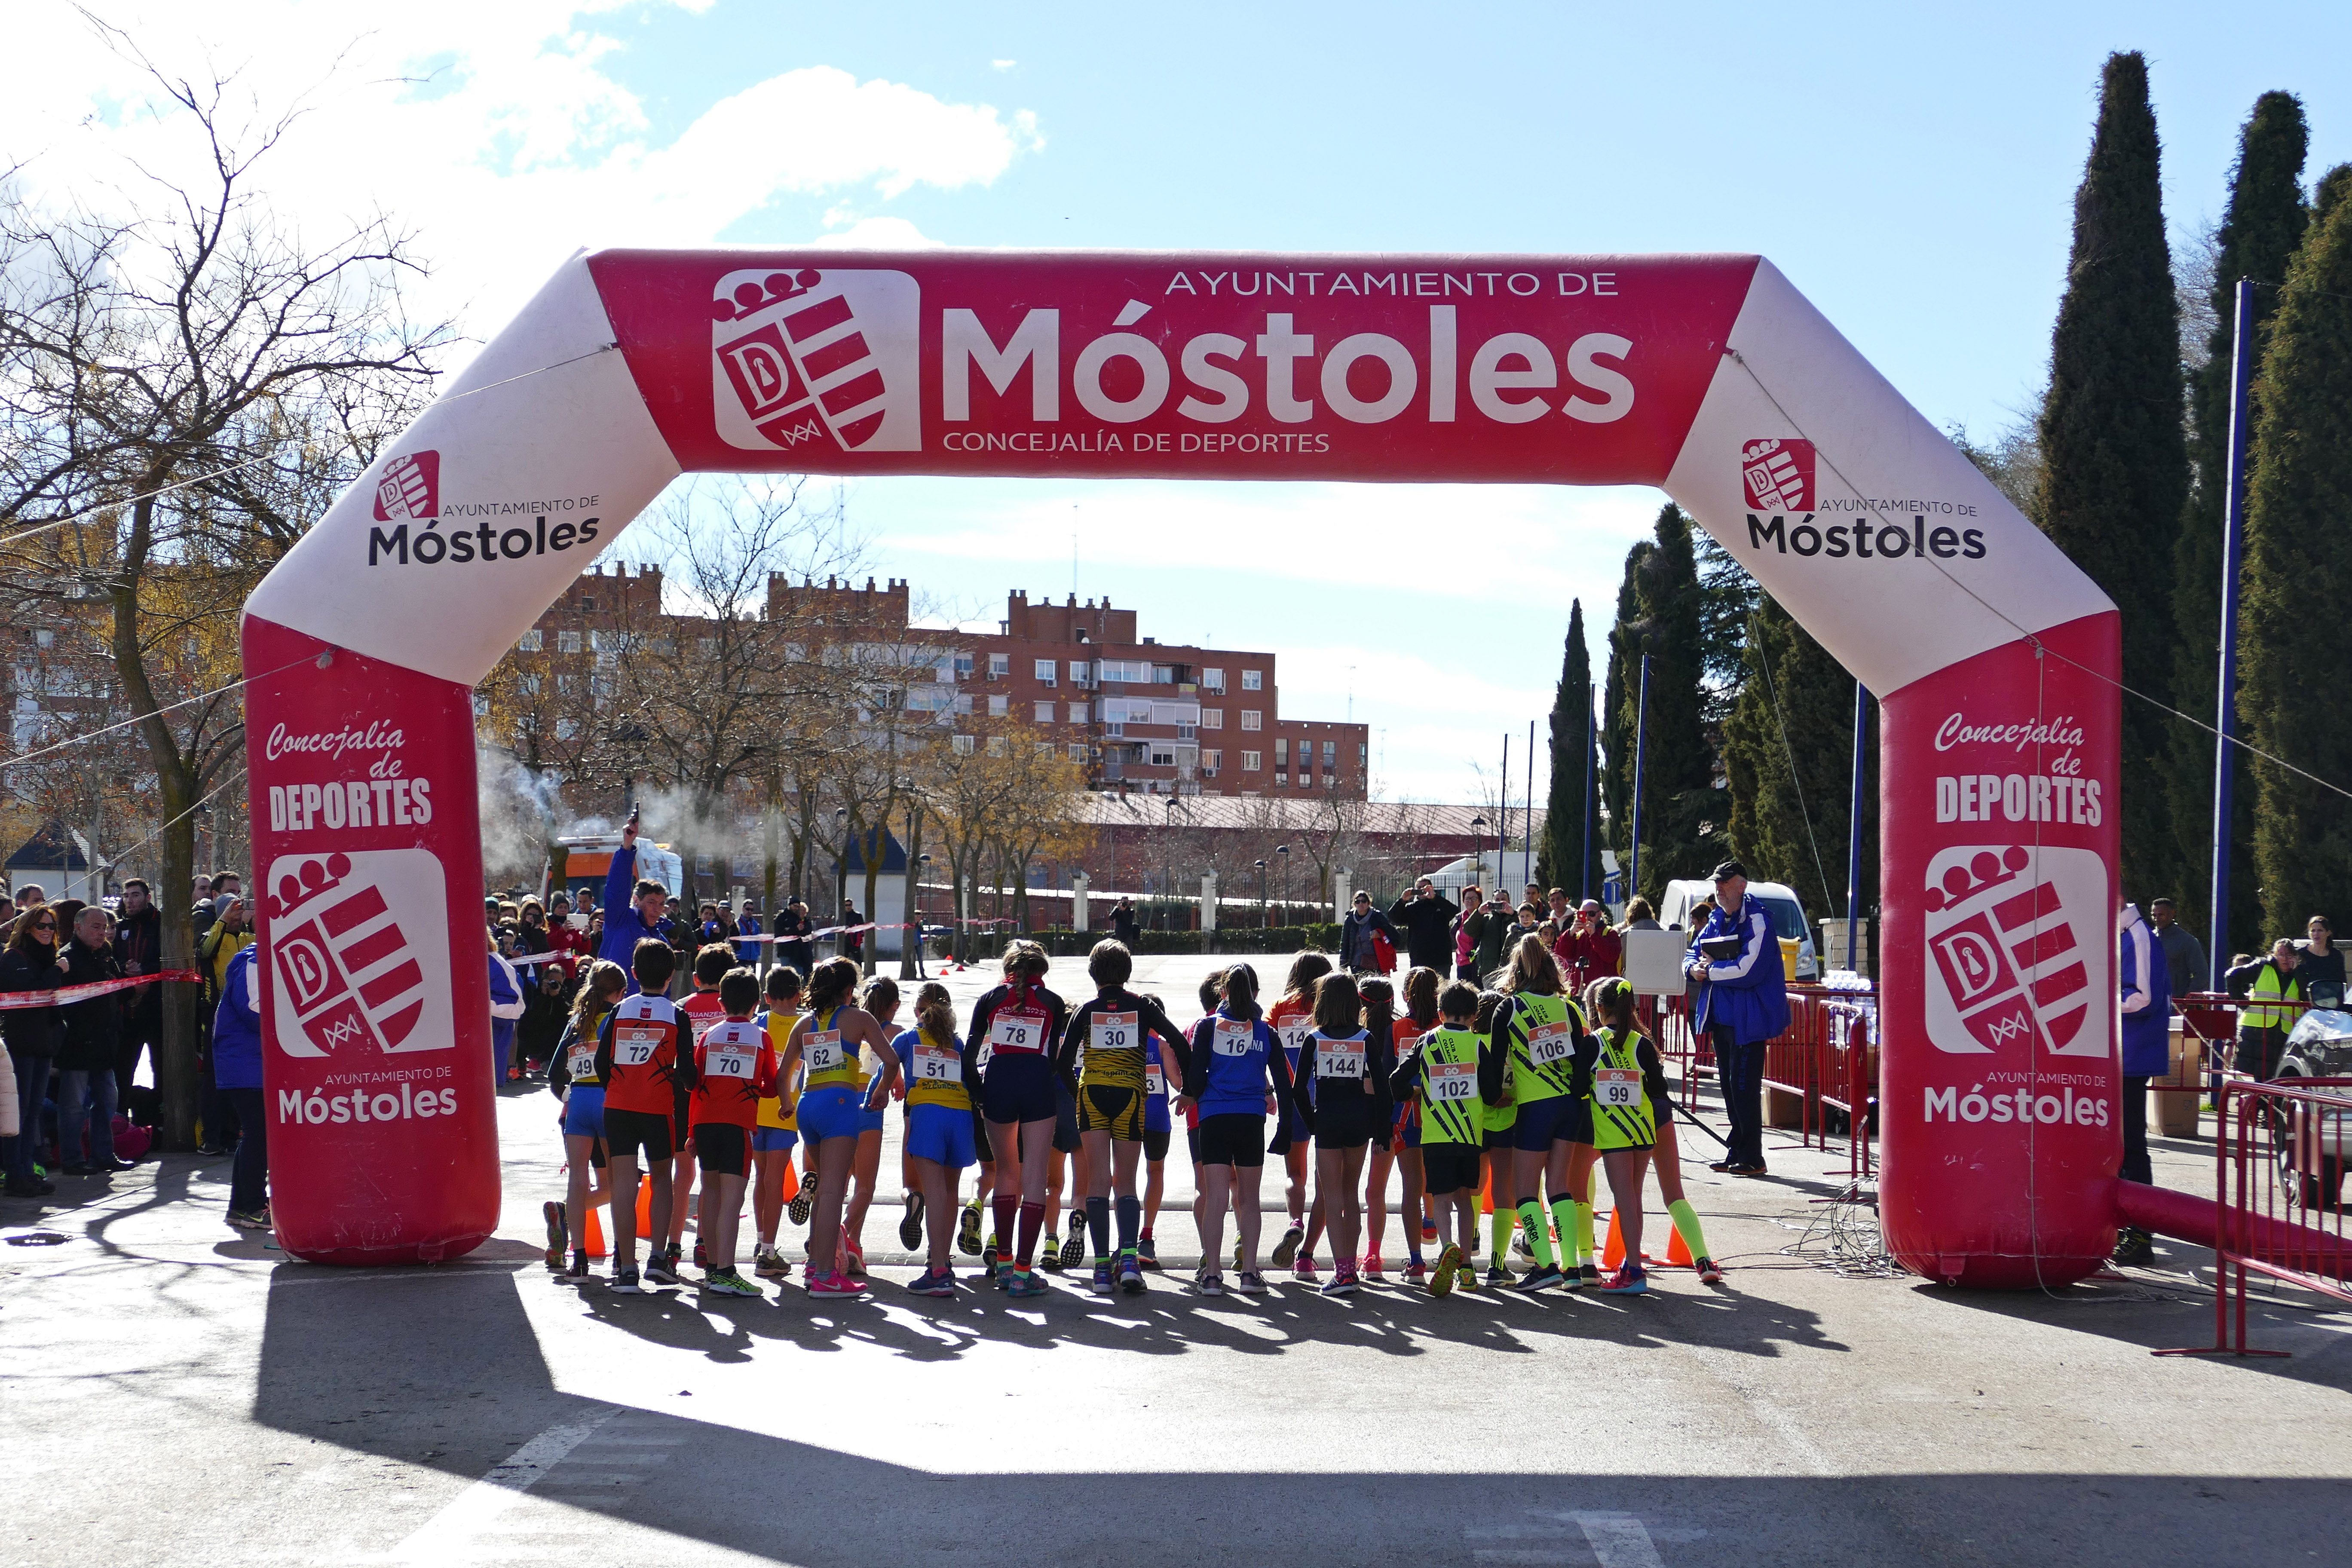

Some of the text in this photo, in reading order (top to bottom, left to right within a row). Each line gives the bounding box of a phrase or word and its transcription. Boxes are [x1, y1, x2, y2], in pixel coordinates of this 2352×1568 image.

[1165, 271, 1618, 296] AYUNTAMIENTO DE
[943, 298, 1635, 423] Móstoles
[943, 429, 1330, 453] CONCEJALÍA DE DEPORTES
[443, 495, 599, 517] AYUNTAMIENTO DE
[1820, 499, 1977, 517] AYUNTAMIENTO DE
[369, 516, 600, 566] Móstoles
[1746, 513, 1987, 559] Móstoles
[266, 719, 405, 761] Concejalía
[1935, 712, 2085, 752] Concejalía
[369, 750, 402, 778] de
[2052, 747, 2081, 775] de
[270, 778, 432, 831] DEPORTES
[1936, 774, 2101, 827] DEPORTES
[1539, 1004, 1548, 1018] CLUB
[1006, 1027, 1026, 1044] 78
[1105, 1031, 1125, 1045] 30
[1537, 1029, 1551, 1038] GO
[575, 1046, 586, 1054] GO
[630, 1047, 649, 1062] 72
[1226, 1039, 1245, 1053] 16
[1536, 1040, 1565, 1060] 106
[720, 1059, 740, 1074] 70
[813, 1049, 830, 1066] 62
[1326, 1058, 1356, 1074] 144
[325, 1066, 451, 1085] AYUNTAMIENTO DE
[576, 1060, 592, 1075] 49
[927, 1062, 945, 1078] 51
[1439, 1081, 1469, 1096] 102
[1987, 1072, 2106, 1087] AYUNTAMIENTO DE
[279, 1082, 457, 1124] Móstoles
[1609, 1087, 1629, 1102] 99
[1925, 1083, 2109, 1127] Móstoles
